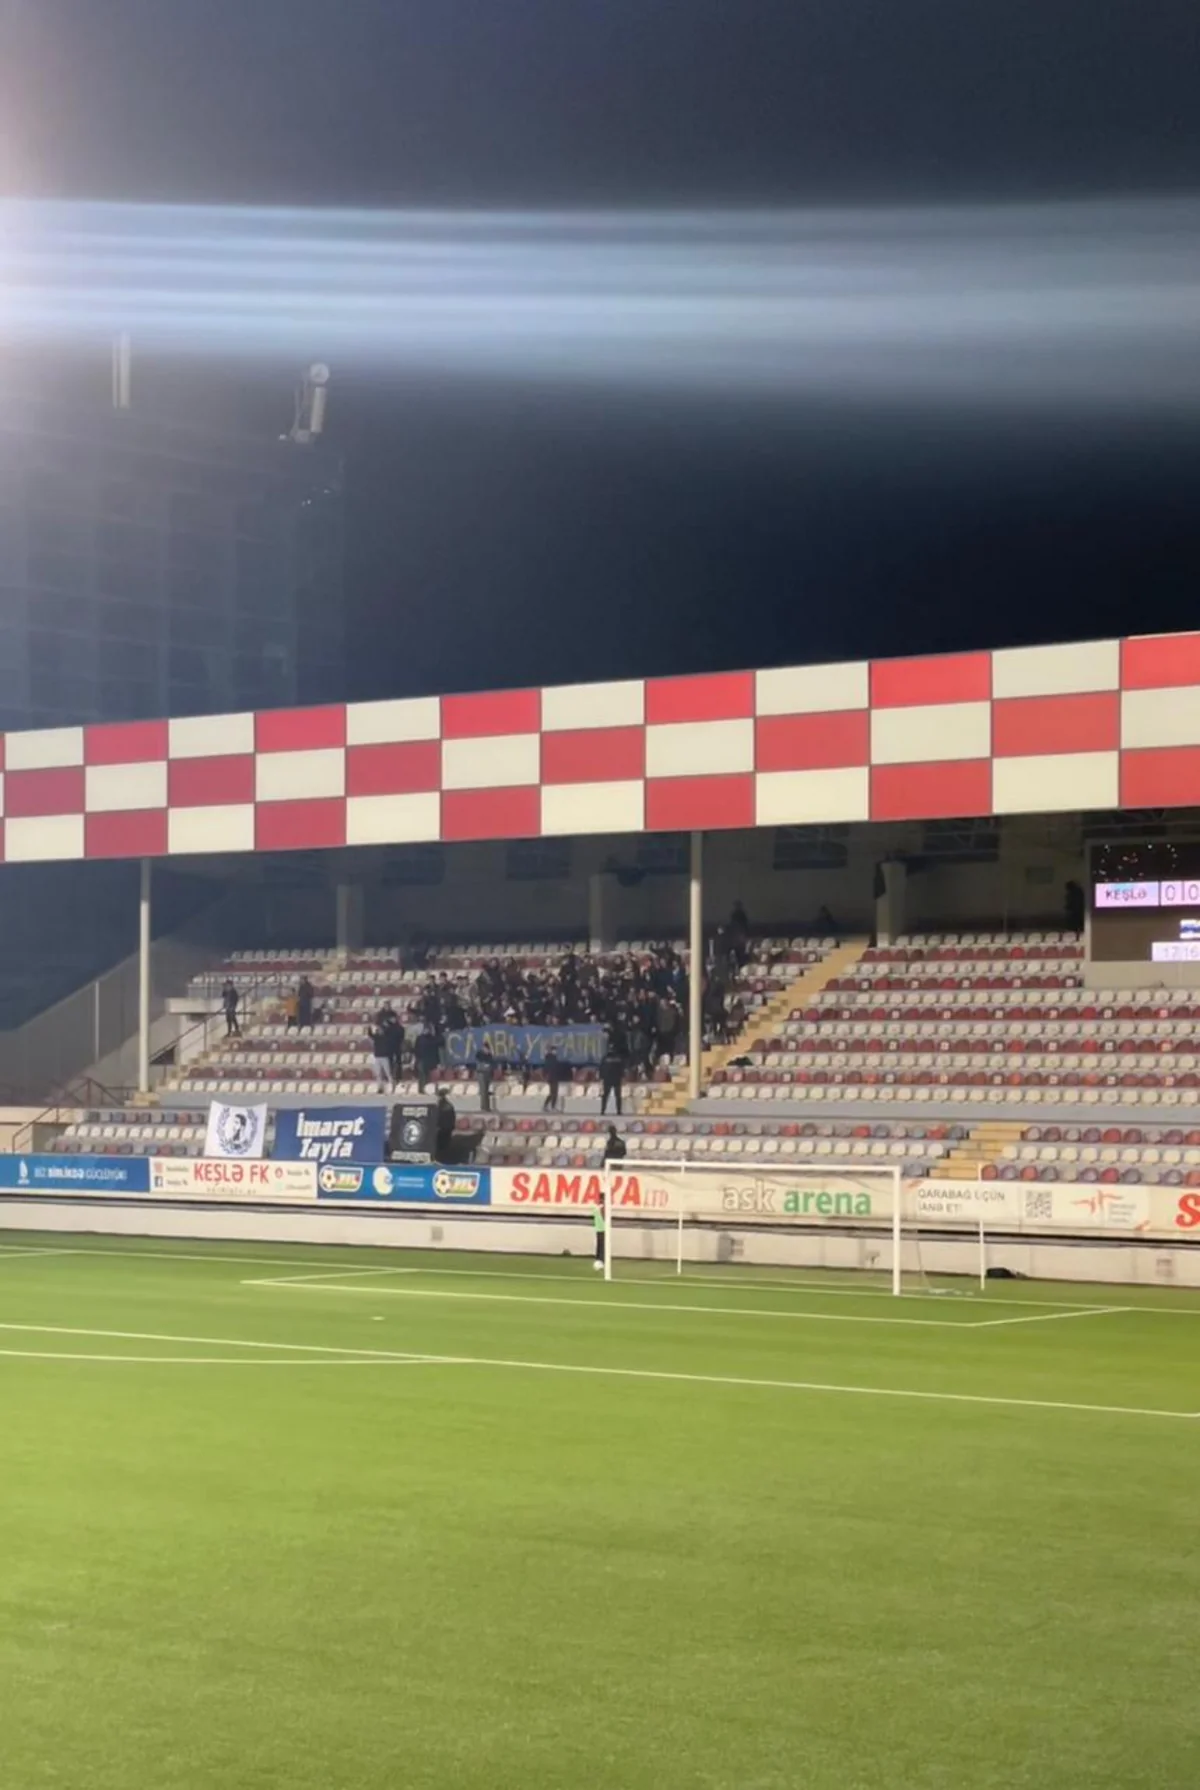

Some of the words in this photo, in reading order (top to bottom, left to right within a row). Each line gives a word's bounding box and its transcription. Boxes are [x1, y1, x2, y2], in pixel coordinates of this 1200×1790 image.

[193, 1162, 244, 1186] KEŞLƏ
[250, 1164, 269, 1184] FK
[722, 1178, 775, 1212] ask
[783, 1189, 871, 1215] arena
